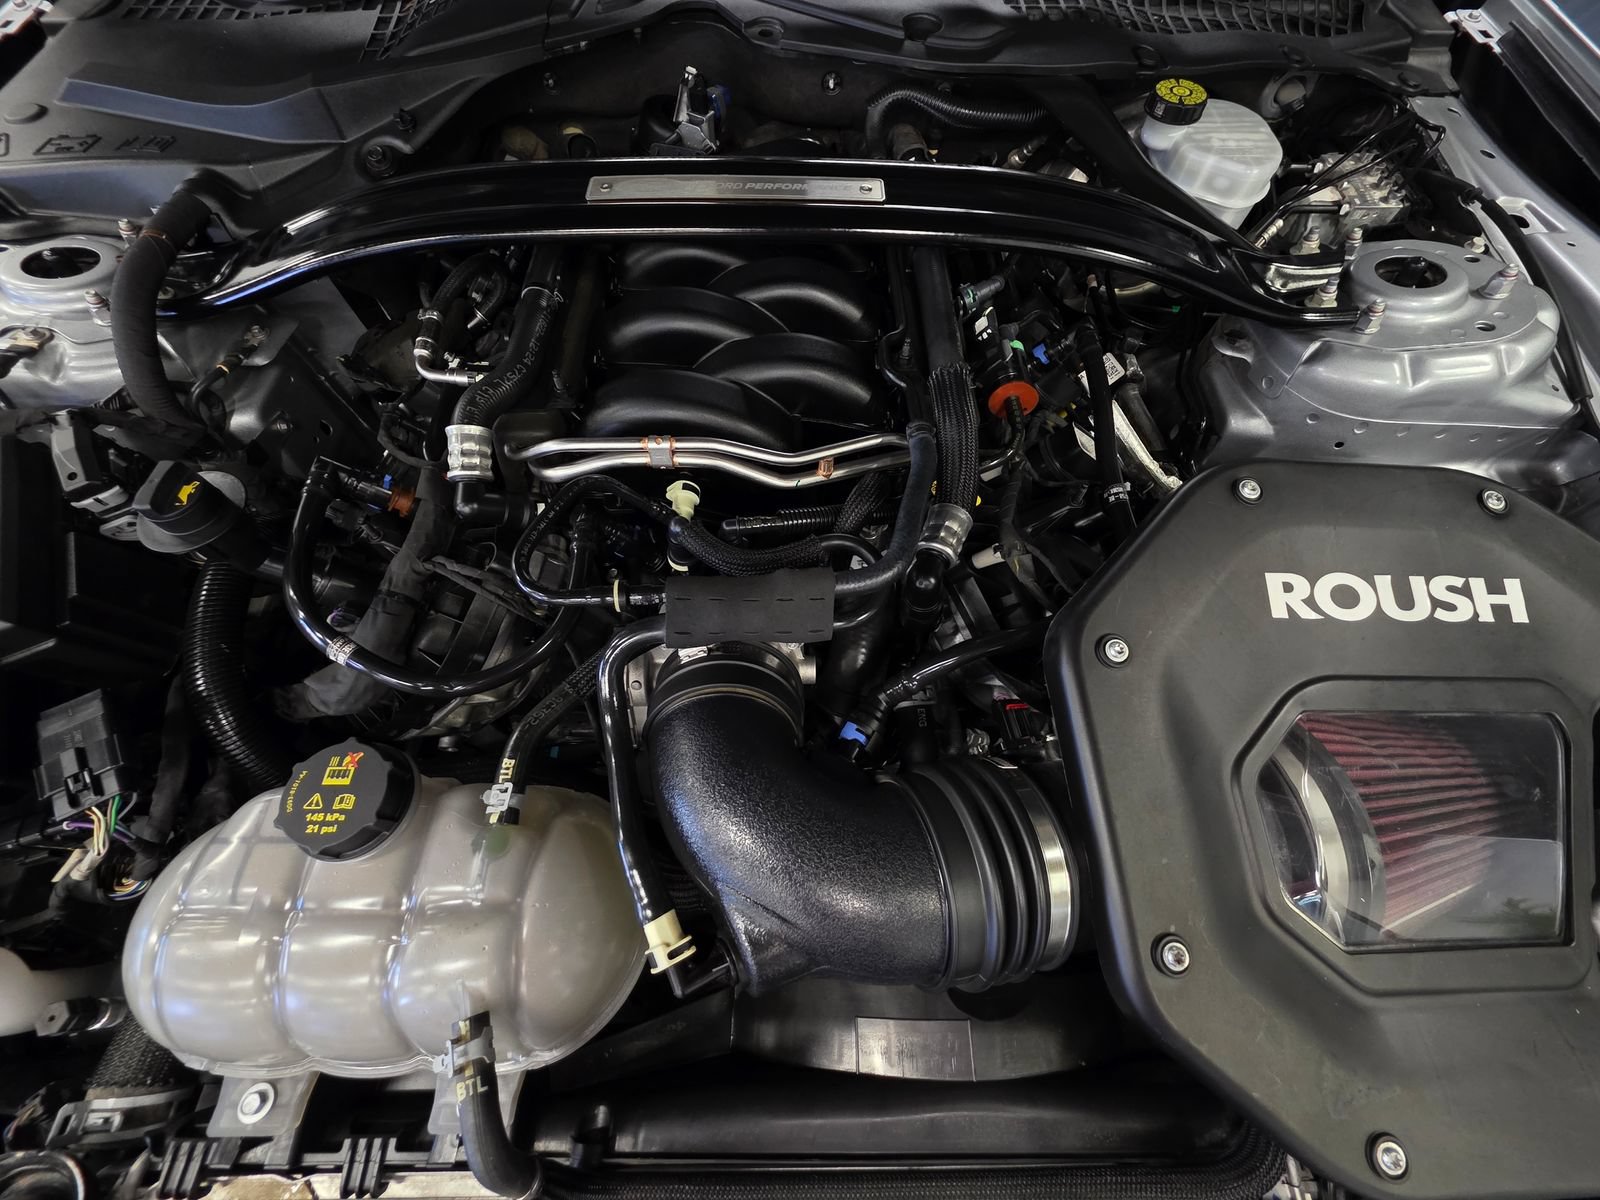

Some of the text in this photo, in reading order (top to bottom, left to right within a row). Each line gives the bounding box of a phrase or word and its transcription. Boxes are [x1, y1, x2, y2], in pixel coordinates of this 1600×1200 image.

[1264, 572, 1530, 623] ROUSH
[917, 708, 928, 728] ENG
[498, 758, 516, 784] BTL
[305, 813, 346, 822] 145 kPa
[305, 824, 338, 834] 21 psi
[456, 1075, 489, 1102] BTL
